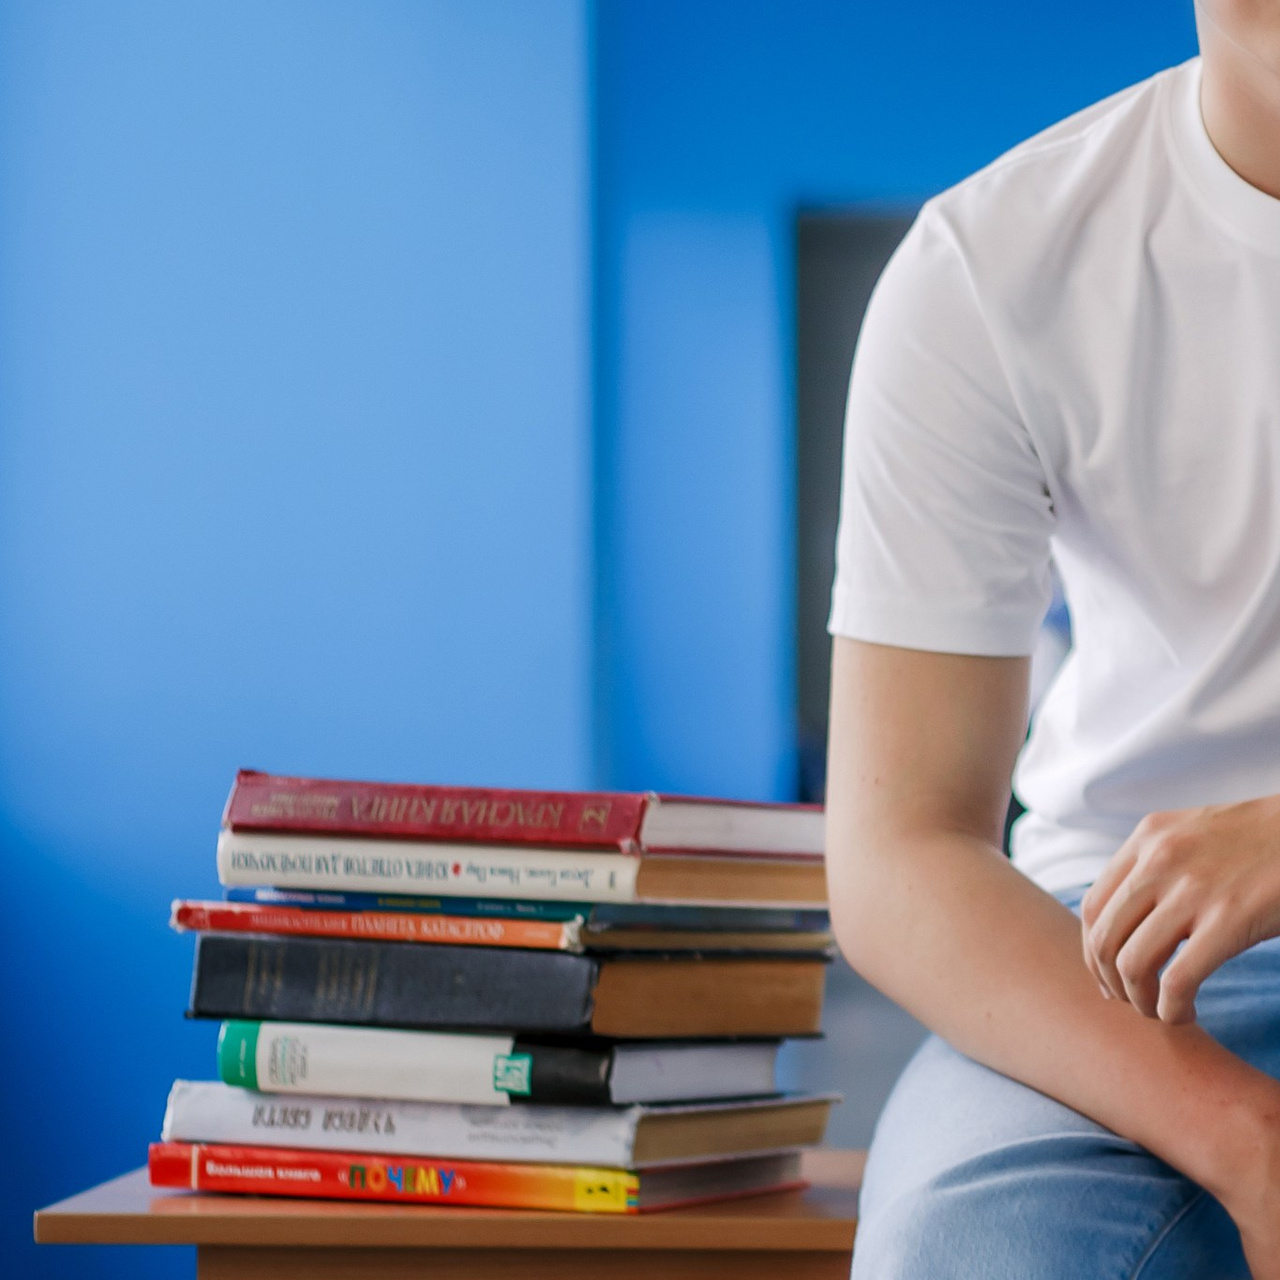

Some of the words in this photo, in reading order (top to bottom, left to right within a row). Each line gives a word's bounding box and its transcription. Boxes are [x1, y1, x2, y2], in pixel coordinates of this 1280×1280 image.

[350, 795, 437, 824] КНИГА
[440, 799, 564, 829] КРАСНАЯ
[205, 1159, 274, 1179] Большая
[276, 1166, 321, 1182] книга
